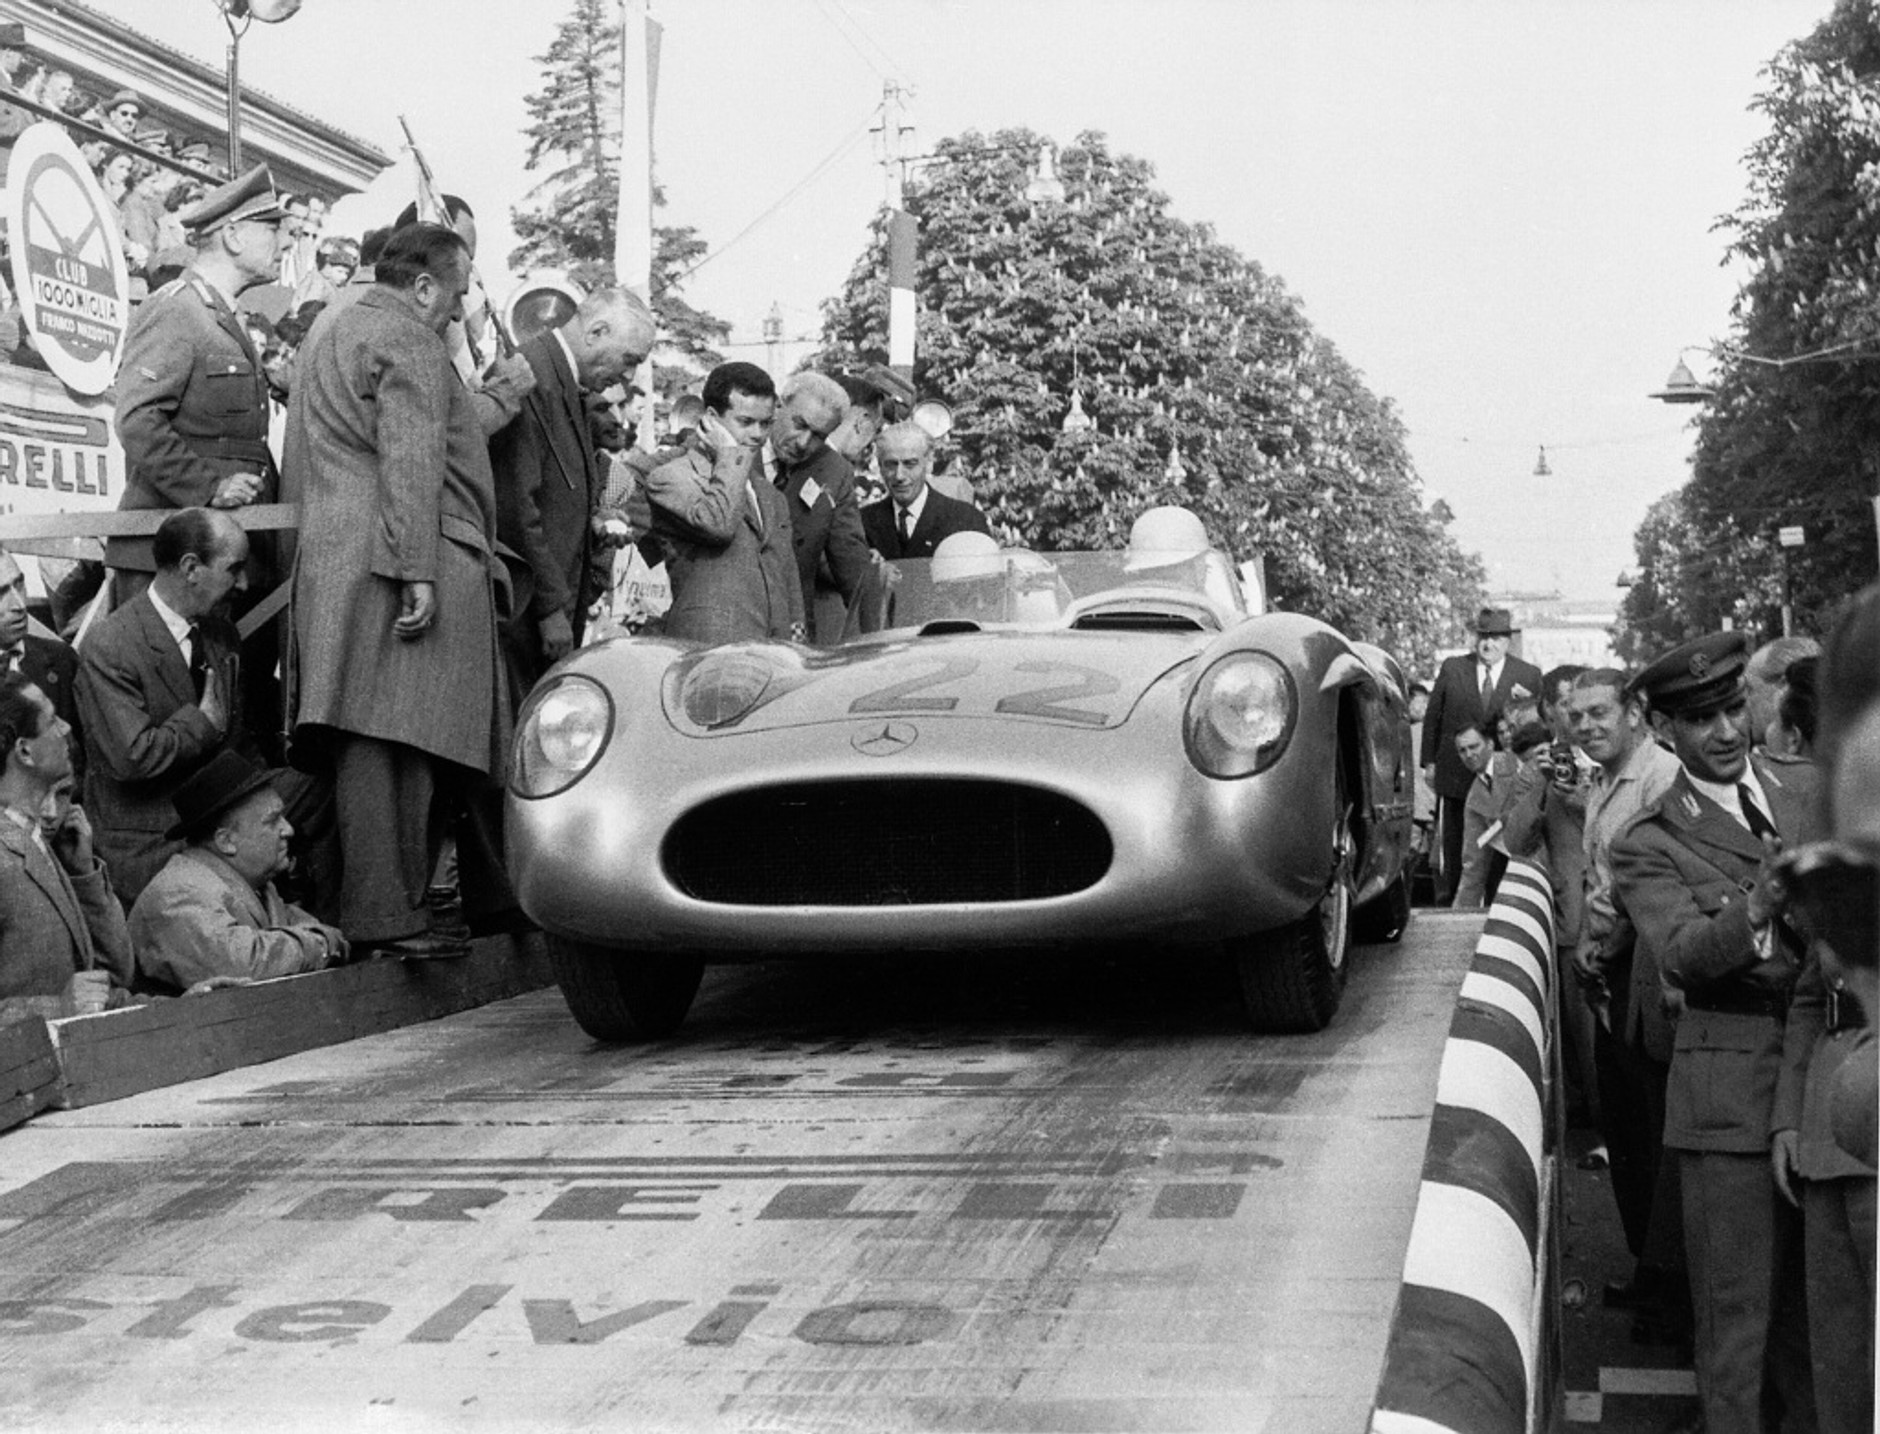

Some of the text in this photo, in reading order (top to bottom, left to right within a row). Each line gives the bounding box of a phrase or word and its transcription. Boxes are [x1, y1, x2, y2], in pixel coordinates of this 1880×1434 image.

[55, 257, 88, 287] CLUB
[849, 658, 1121, 725] 22
[0, 1284, 952, 1347] stelvio
